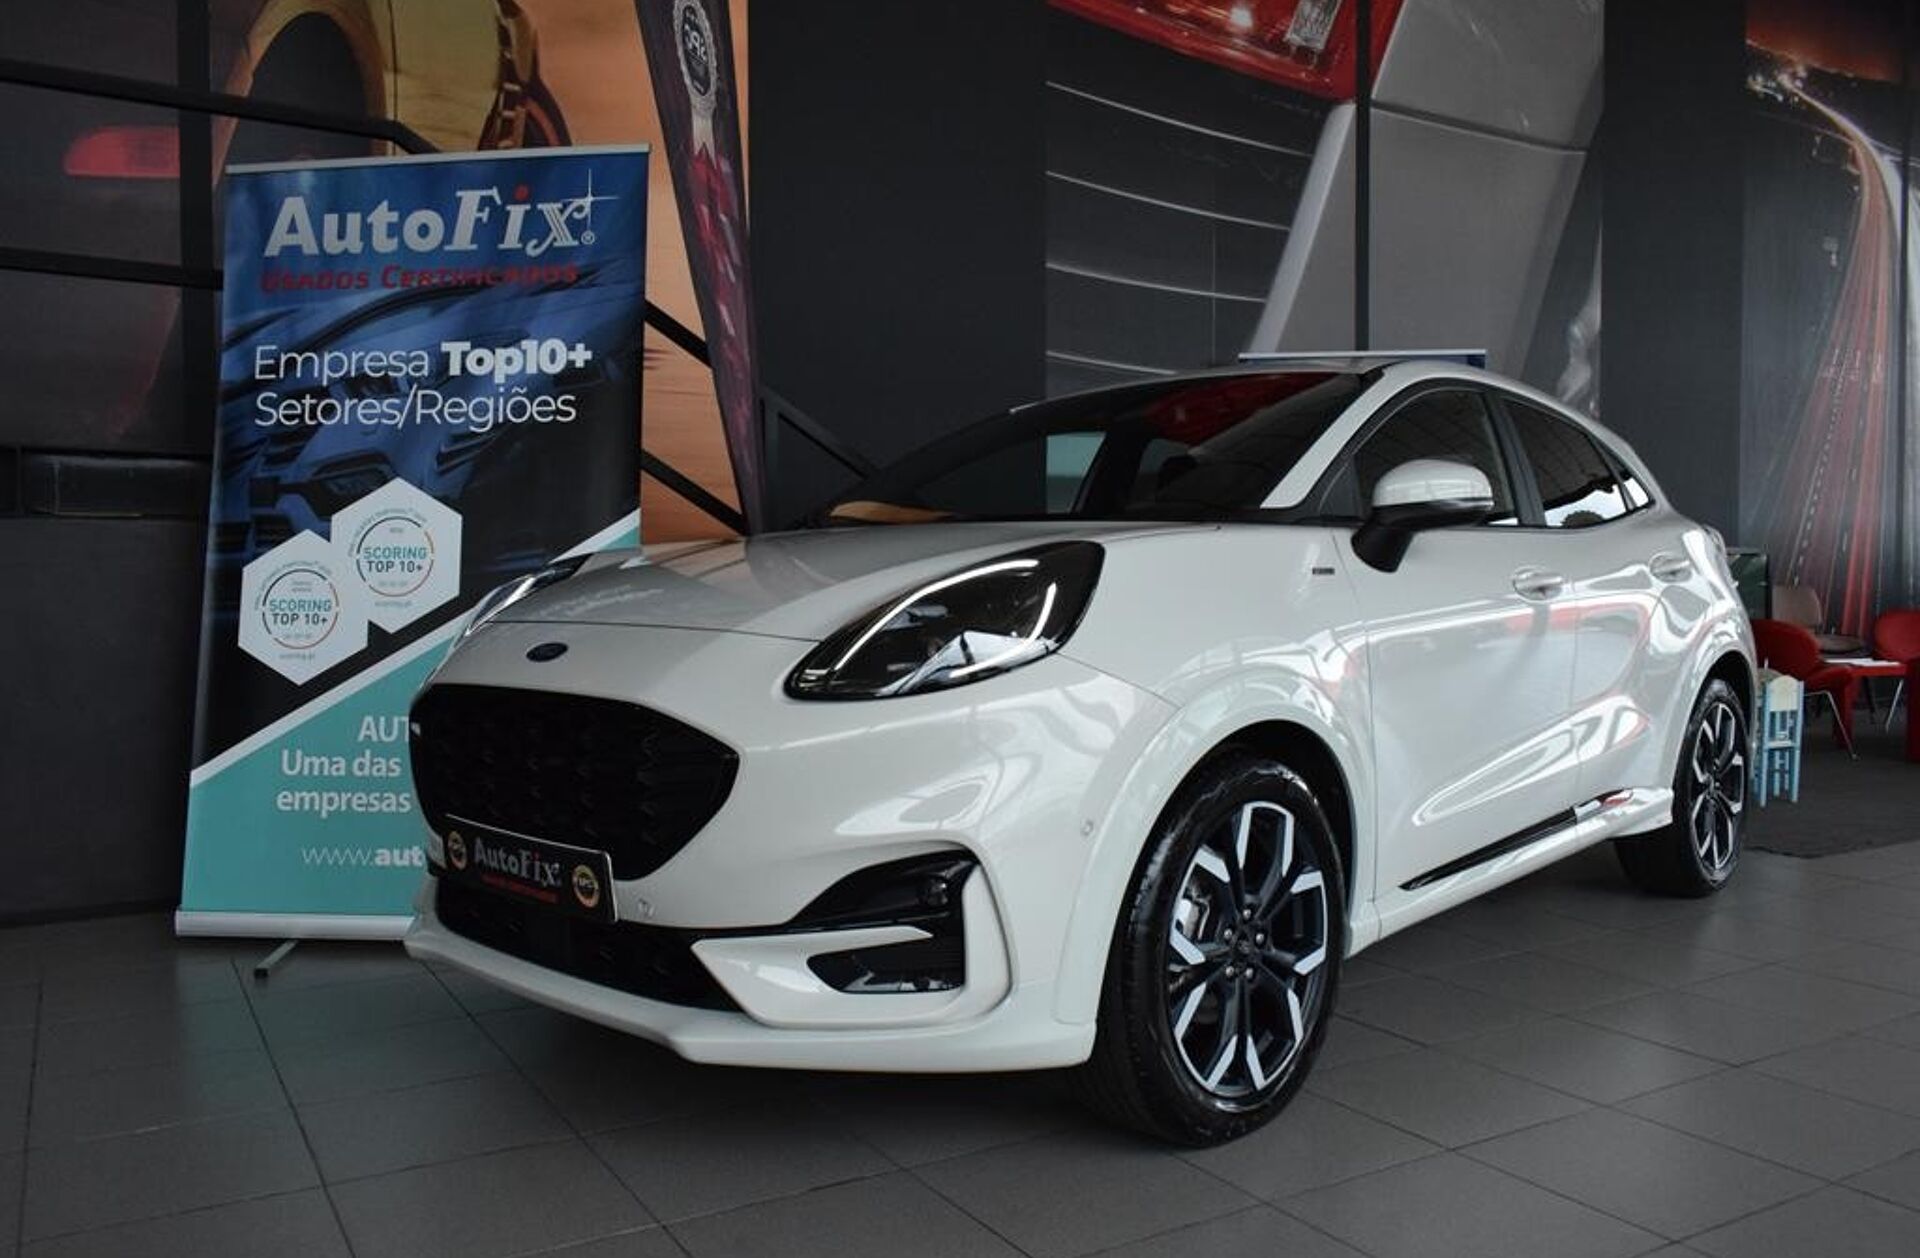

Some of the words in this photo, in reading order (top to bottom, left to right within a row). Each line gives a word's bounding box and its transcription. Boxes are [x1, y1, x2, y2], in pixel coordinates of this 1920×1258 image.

[254, 344, 429, 386] Empresa
[440, 338, 593, 383] Top10+
[254, 384, 577, 432] Setores/Regiões
[363, 547, 427, 560] SCORING
[366, 560, 395, 573] TOP
[399, 560, 424, 573] 10+
[269, 599, 332, 612] SCORING
[272, 613, 300, 626] TOP
[304, 613, 329, 626] 10+
[281, 750, 346, 778] Uma
[352, 750, 402, 778] das
[276, 789, 412, 818] empresas
